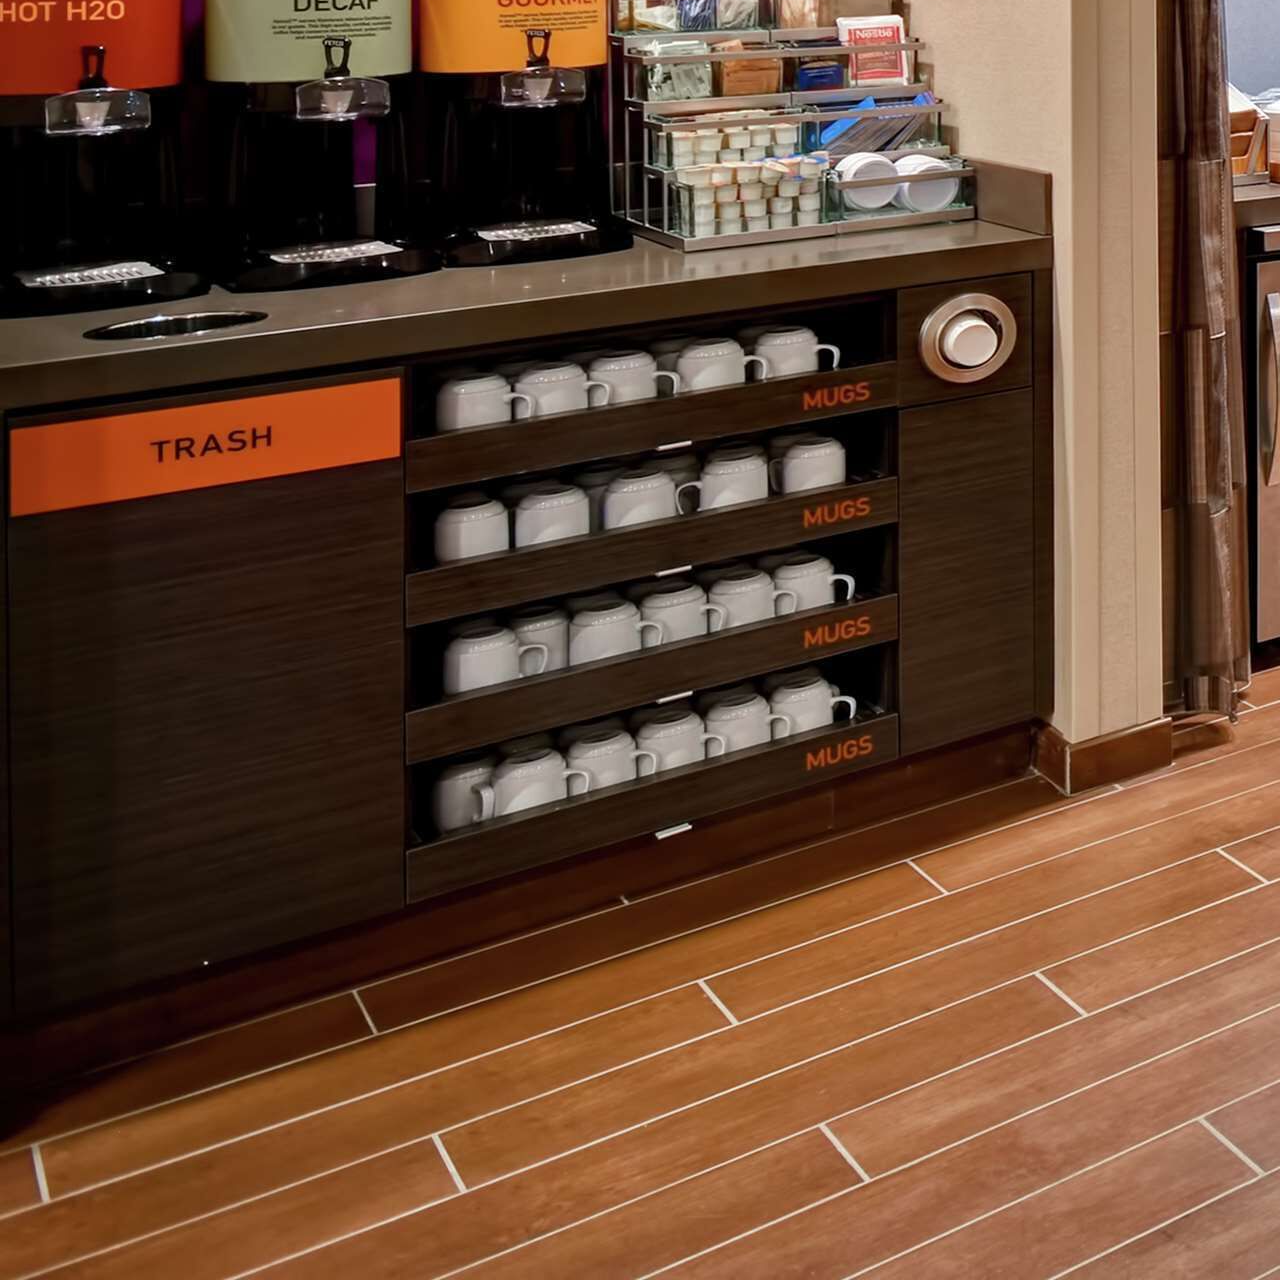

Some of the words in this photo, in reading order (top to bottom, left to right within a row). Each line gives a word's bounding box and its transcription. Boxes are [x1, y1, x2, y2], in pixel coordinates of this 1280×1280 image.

[0, 1, 57, 22] HOT
[802, 380, 871, 411] MUGS
[150, 424, 274, 464] TRASH
[802, 496, 871, 528] MUGS
[802, 614, 871, 649] MUGS
[805, 733, 873, 771] MUGS
